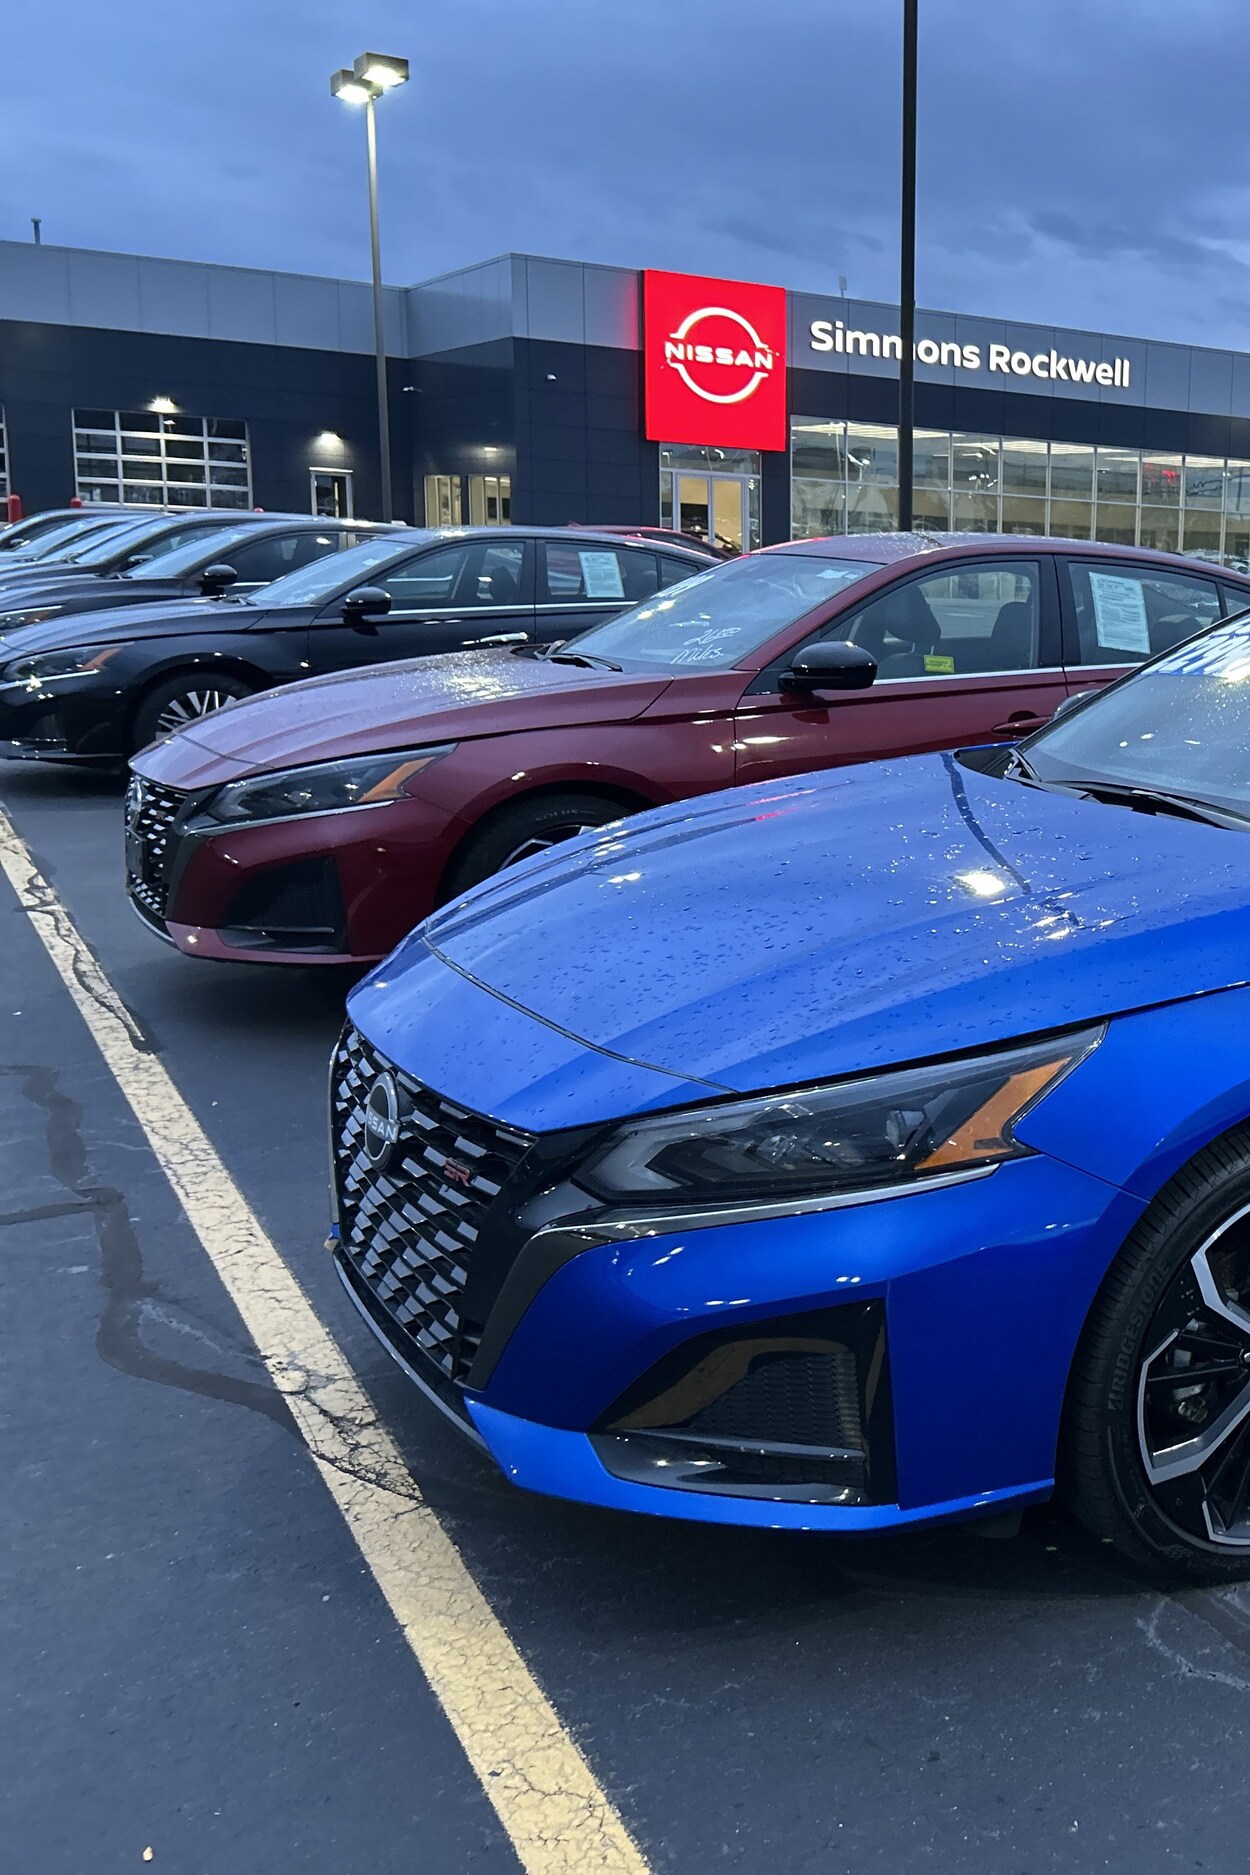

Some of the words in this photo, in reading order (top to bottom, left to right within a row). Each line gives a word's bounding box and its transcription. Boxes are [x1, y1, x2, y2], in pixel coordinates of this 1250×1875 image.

[664, 341, 774, 370] NISSAN
[809, 320, 981, 370] Simmons
[988, 343, 1131, 389] Rockwell
